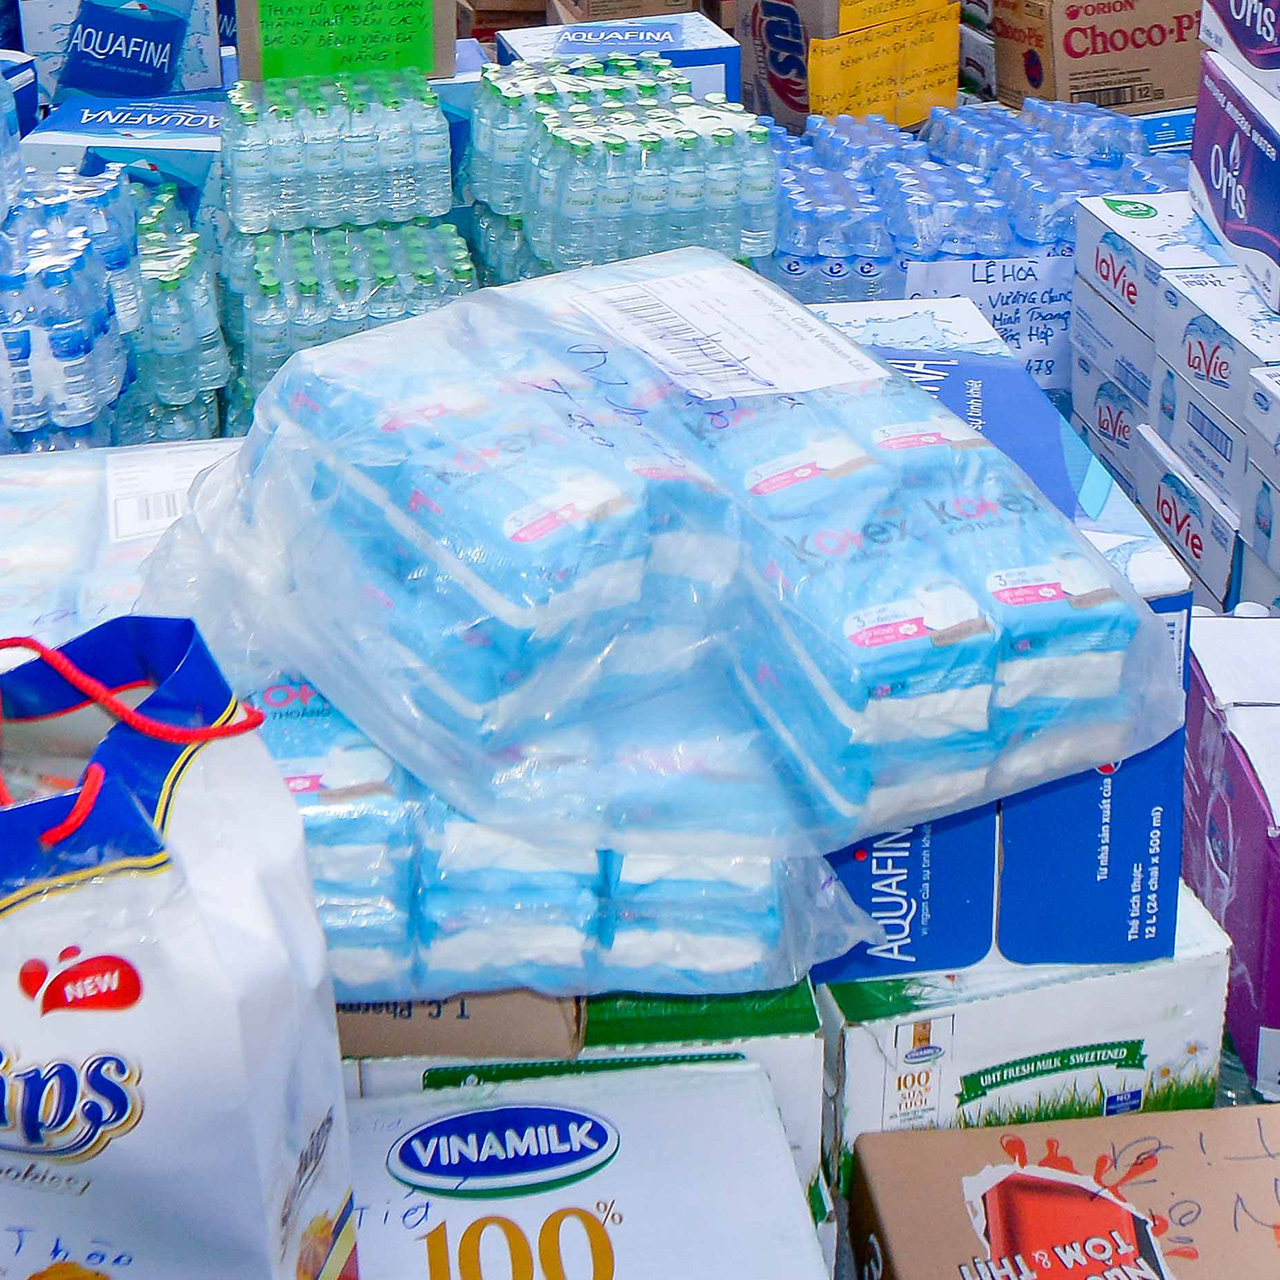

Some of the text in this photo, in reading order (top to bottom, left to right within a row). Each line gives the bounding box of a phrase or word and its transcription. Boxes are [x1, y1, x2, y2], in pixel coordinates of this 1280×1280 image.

[67, 21, 173, 74] AQUAFINA
[557, 27, 675, 45] AQUAFINA
[1136, 85, 1151, 100] 12
[80, 106, 221, 131] AQUAFINA
[1250, 129, 1278, 162] WATER
[1209, 143, 1248, 221] Oris
[1150, 830, 1163, 855] 500
[865, 826, 918, 964] AQUAFIN
[1145, 925, 1157, 940] 12
[64, 970, 121, 1002] NEW
[980, 1047, 1127, 1088] UHT FRESH MILK SWEETENED
[409, 1120, 600, 1169] VINAMILK
[1053, 1227, 1135, 1264] TÔM
